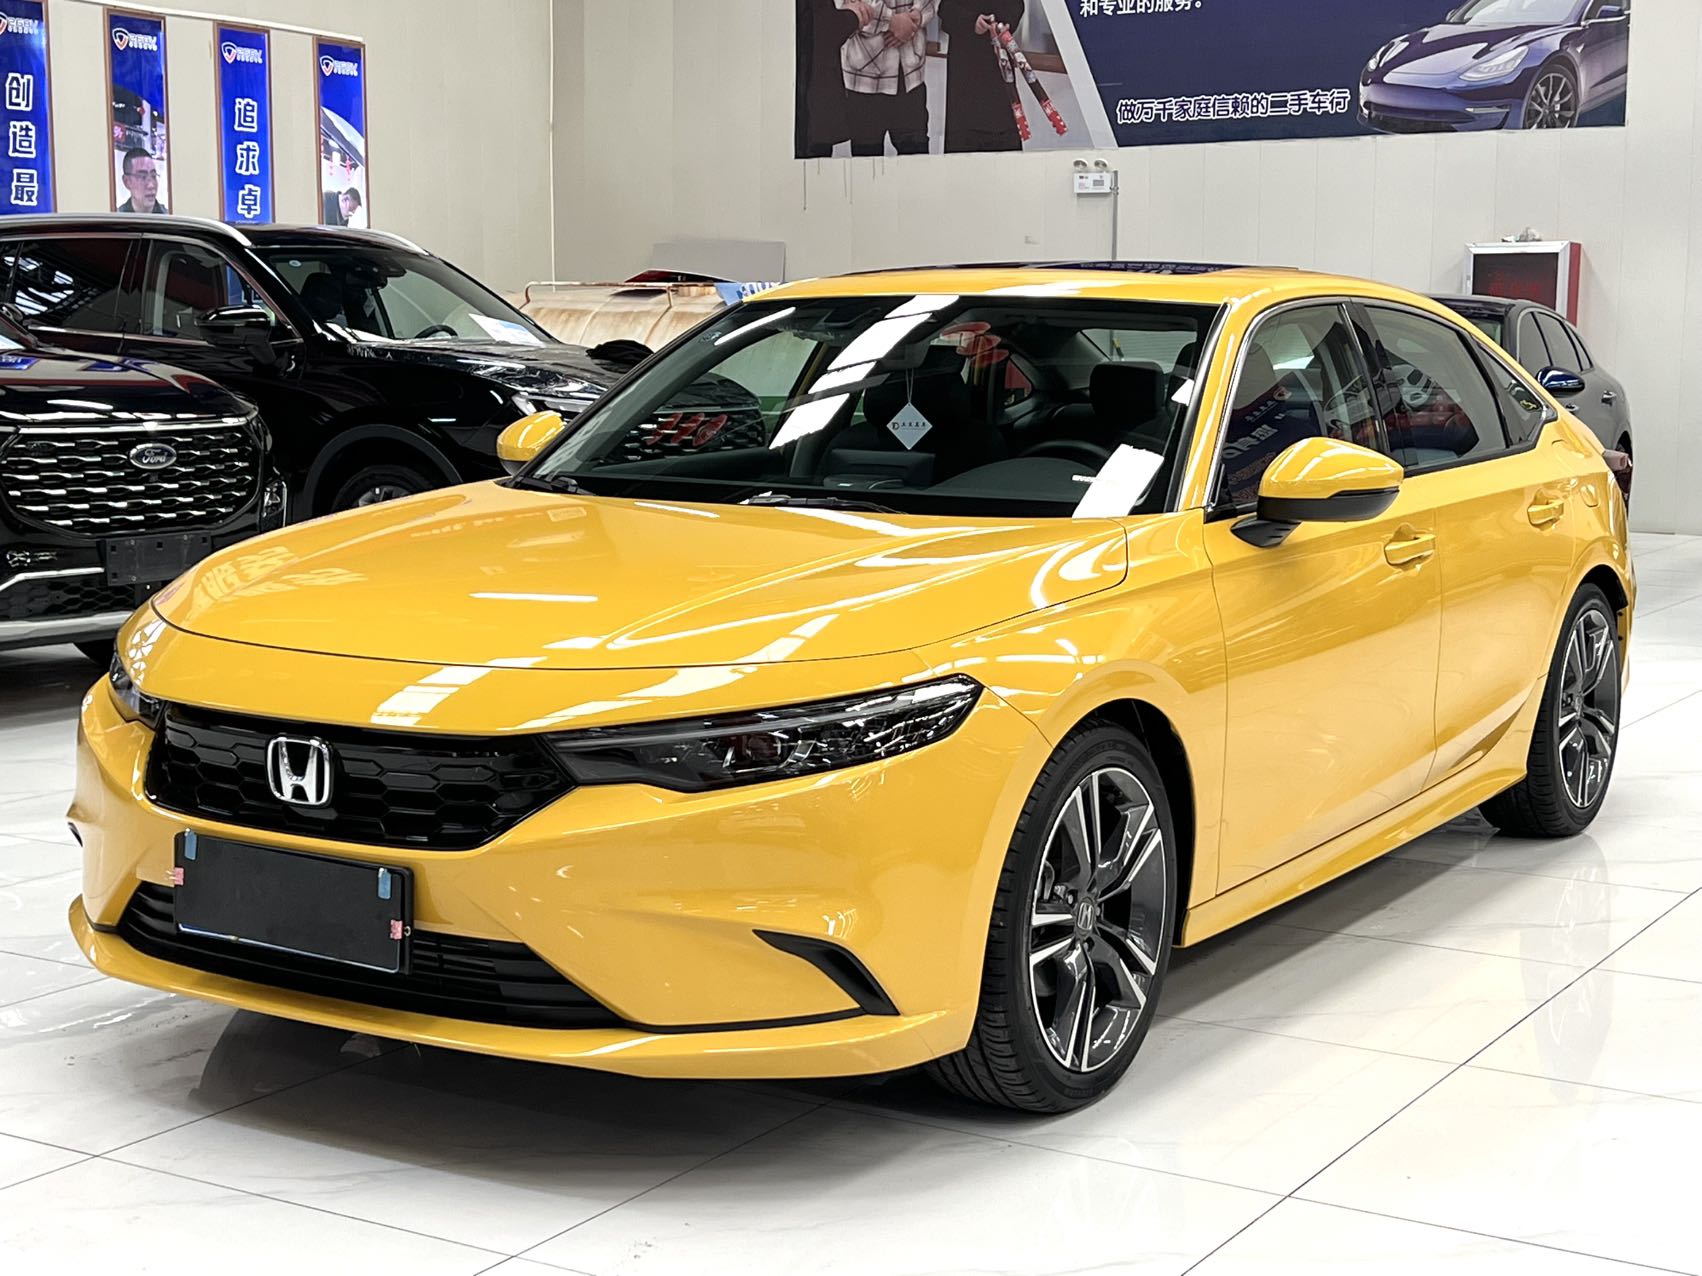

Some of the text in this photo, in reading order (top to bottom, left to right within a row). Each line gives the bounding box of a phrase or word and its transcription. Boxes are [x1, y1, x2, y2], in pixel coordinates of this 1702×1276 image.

[6, 72, 38, 207] 创造最
[1116, 89, 1350, 124] 做万千家庭信赖的二手车行
[234, 97, 261, 219] 追求卓
[142, 448, 168, 464] Ford
